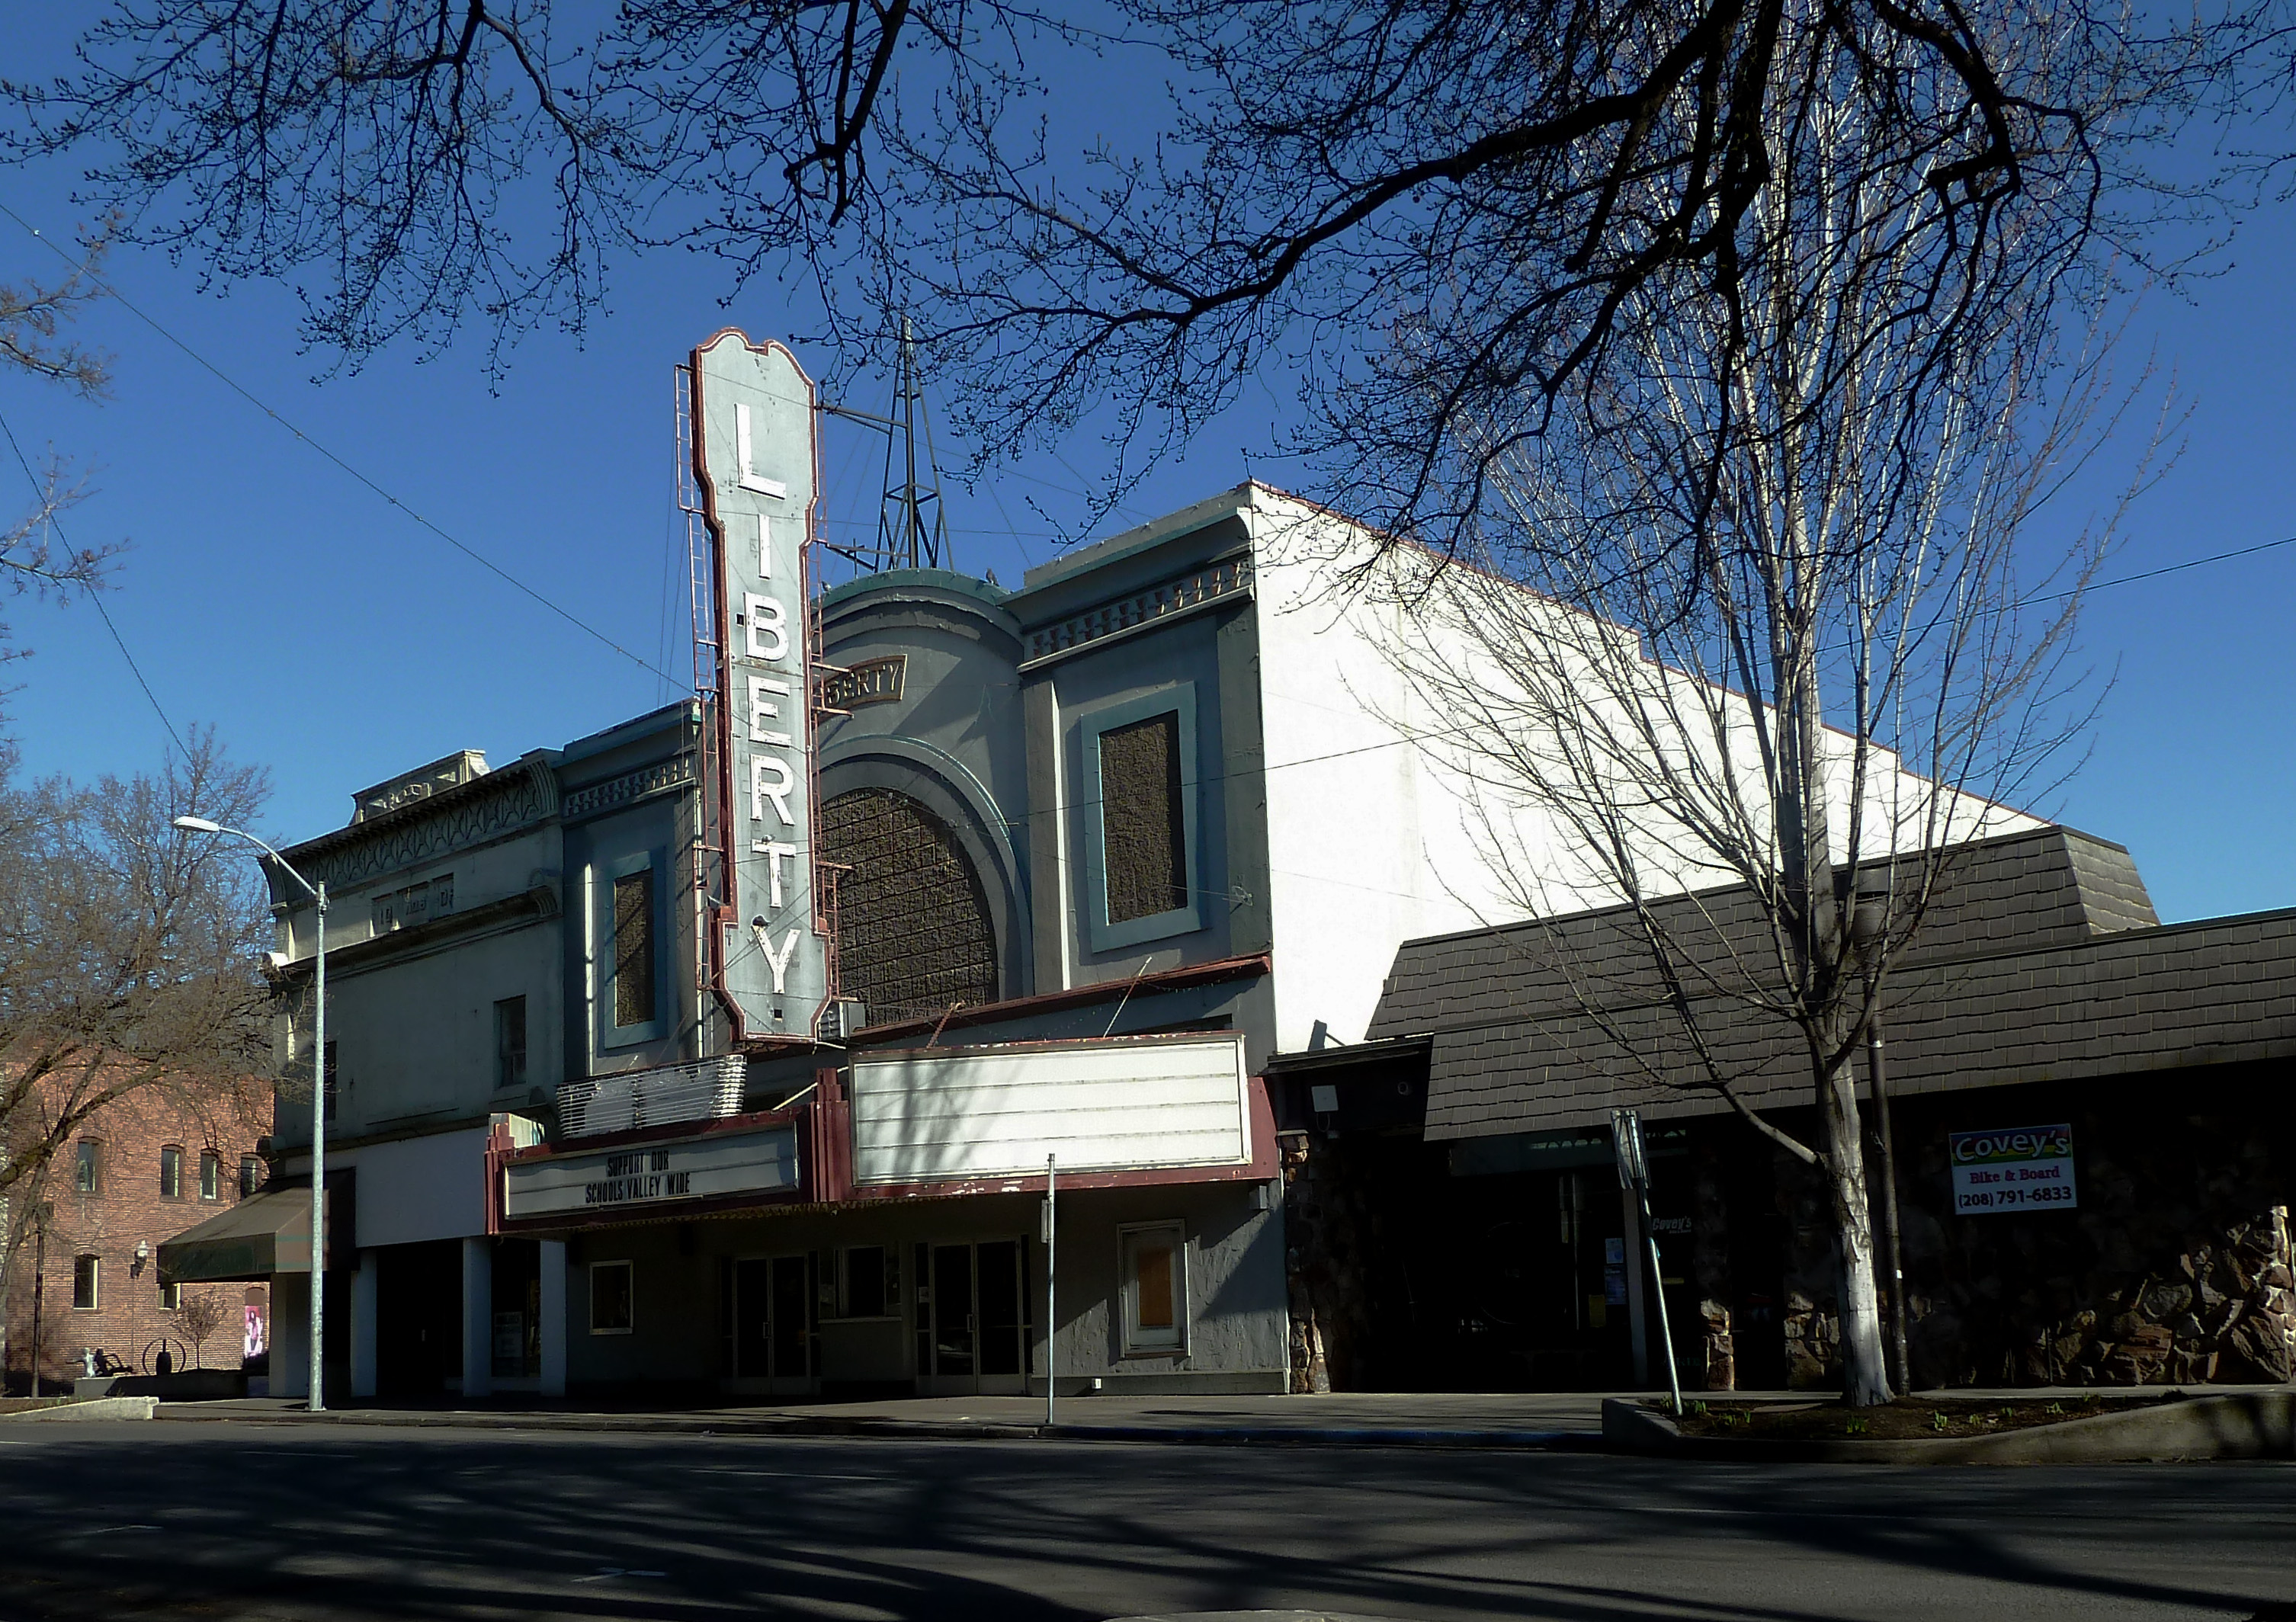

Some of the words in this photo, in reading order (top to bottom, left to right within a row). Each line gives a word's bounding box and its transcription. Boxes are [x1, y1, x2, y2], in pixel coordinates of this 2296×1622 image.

[734, 403, 802, 994] LIBERTY
[826, 663, 901, 704] BERTY
[1955, 1130, 2070, 1162] Covey's
[608, 1152, 644, 1177] SUPPORT
[652, 1150, 669, 1172] OUR
[1970, 1172, 2000, 1184] Bike
[2005, 1169, 2015, 1181] &
[2019, 1166, 2060, 1181] Board
[585, 1181, 623, 1204] SCHOOLS
[627, 1175, 660, 1199] VALLEY
[667, 1172, 690, 1195] WIDE
[1958, 1192, 1993, 1208] (208)
[1996, 1186, 2072, 1204] 791-6833
